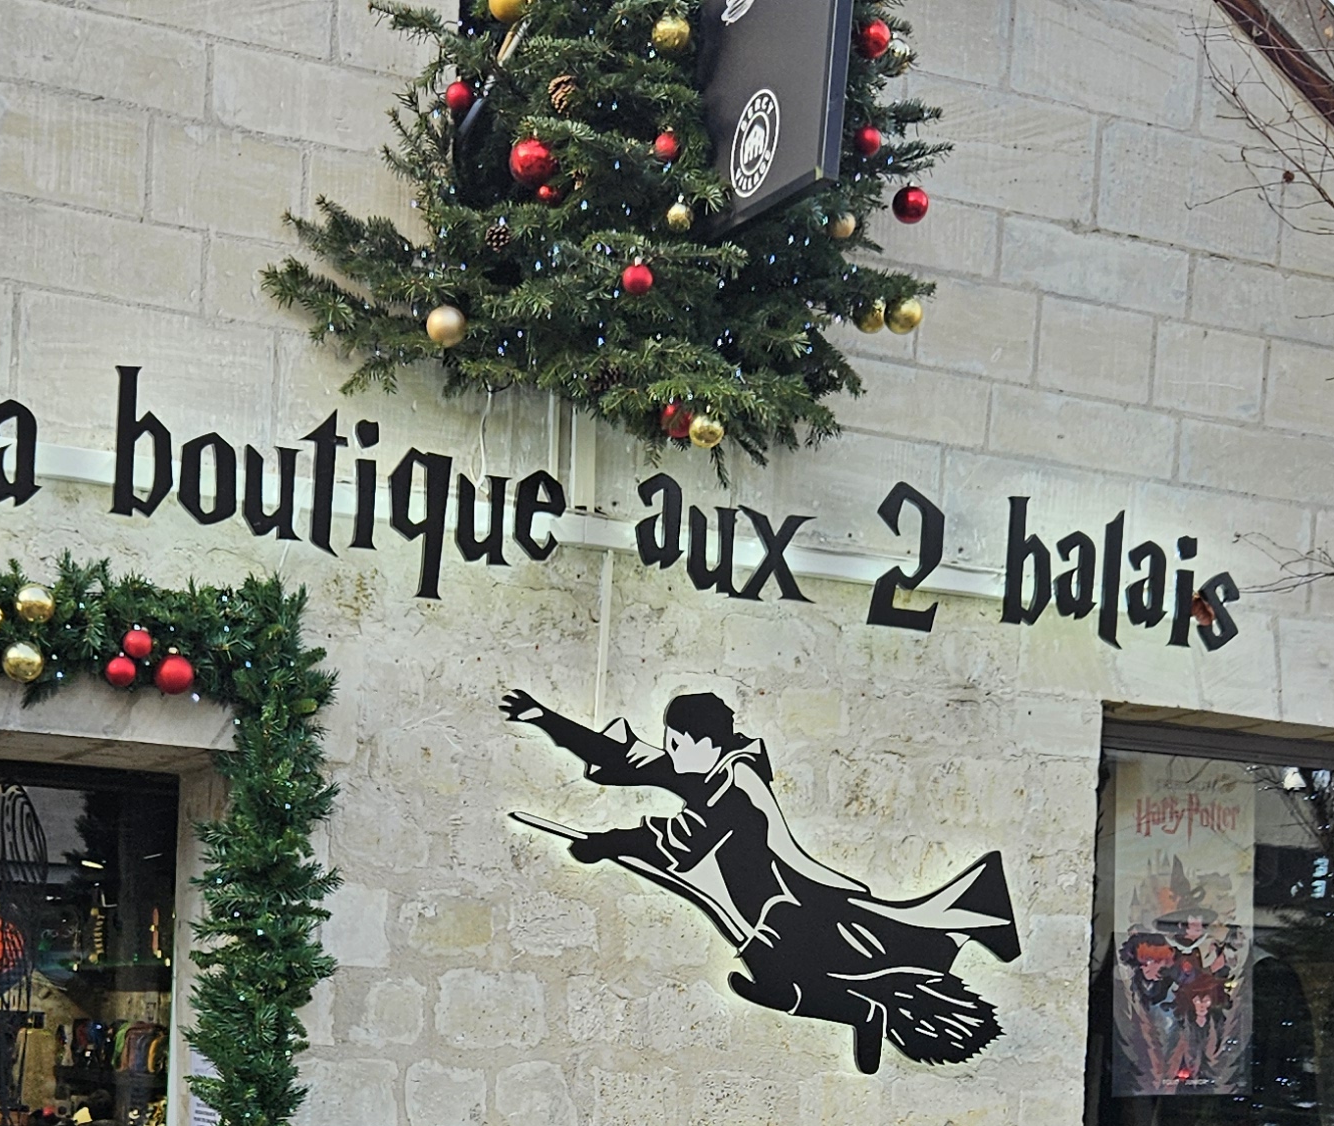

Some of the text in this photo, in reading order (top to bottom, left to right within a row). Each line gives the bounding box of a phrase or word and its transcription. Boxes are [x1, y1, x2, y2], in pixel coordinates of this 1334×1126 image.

[109, 365, 567, 599] boutique
[636, 472, 817, 603] aux
[866, 481, 945, 633] 2
[998, 495, 1240, 652] balais
